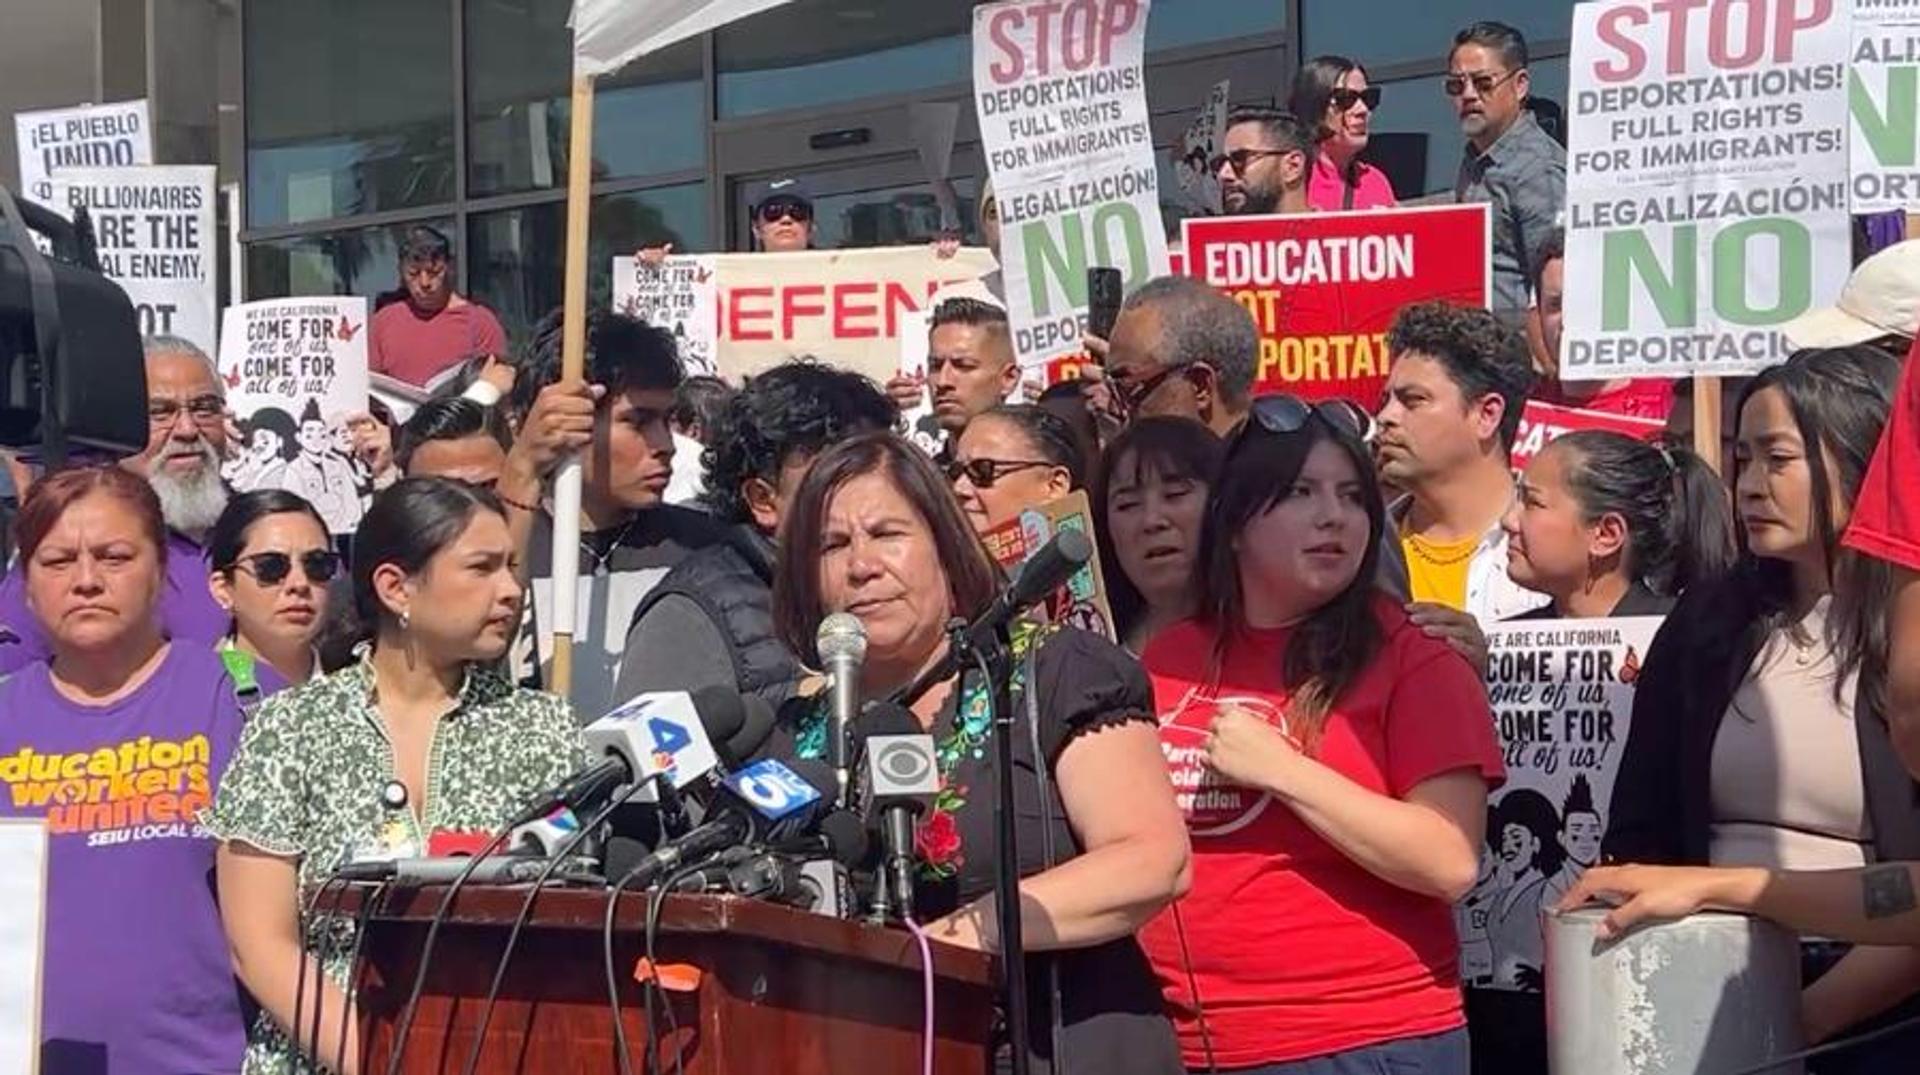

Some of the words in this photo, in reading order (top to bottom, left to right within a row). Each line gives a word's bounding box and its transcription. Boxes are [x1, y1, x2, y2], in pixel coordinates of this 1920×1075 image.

[990, 0, 1138, 84] STOP
[1593, 0, 1832, 83] STOP
[982, 66, 1140, 116] DEPORTATIONS!
[1577, 64, 1843, 115] DEPORTATIONS!
[32, 122, 61, 149] ¡EL
[66, 113, 139, 141] PUEBLO
[1009, 115, 1056, 140] FULL
[1060, 101, 1122, 130] RIGHTS
[1611, 116, 1682, 142] FULL
[1692, 102, 1803, 134] RIGHTS
[992, 147, 1029, 172] FOR
[1033, 122, 1147, 163] IMMIGRANTS!
[1574, 151, 1630, 174] FOR
[1642, 129, 1842, 168] IMMIGRANTS!
[68, 186, 202, 209] BILLIONAIRES
[1000, 167, 1156, 225] LEGALIZACIÓN!
[1572, 177, 1844, 229] LEGALIZACIÓN!
[97, 216, 136, 249] RE
[146, 215, 199, 249] THE
[102, 254, 124, 279] AL
[130, 254, 205, 283] ENEMY,
[1022, 201, 1149, 318] NO
[1205, 234, 1414, 287] EDUCATION
[1601, 217, 1812, 332] NO
[135, 304, 176, 334] OT
[247, 319, 292, 341] COME
[300, 318, 335, 339] FOR
[717, 280, 950, 341] EFEN
[1225, 290, 1281, 333] OT
[244, 356, 292, 378] COME
[301, 355, 336, 377] FOR
[248, 342, 278, 355] one
[284, 339, 302, 357] of
[245, 379, 271, 394] all
[278, 376, 298, 398] of
[304, 376, 334, 395] us!
[1506, 632, 1533, 647] ARE
[1536, 629, 1621, 647] CALIFORNIA
[1487, 650, 1553, 682] COME
[1565, 650, 1615, 682] FOR
[1489, 683, 1532, 704] one
[1540, 679, 1568, 711] of
[1578, 683, 1610, 709] us,
[648, 717, 692, 755] 4
[1492, 710, 1553, 742] OME
[1565, 709, 1616, 742] FOR
[1502, 740, 1529, 767] ll
[1534, 741, 1561, 775] of
[1569, 740, 1610, 770] us!
[11, 763, 210, 807] workers
[1177, 790, 1241, 812] eration
[88, 829, 130, 847] SEIU
[134, 824, 188, 840] LOCAL
